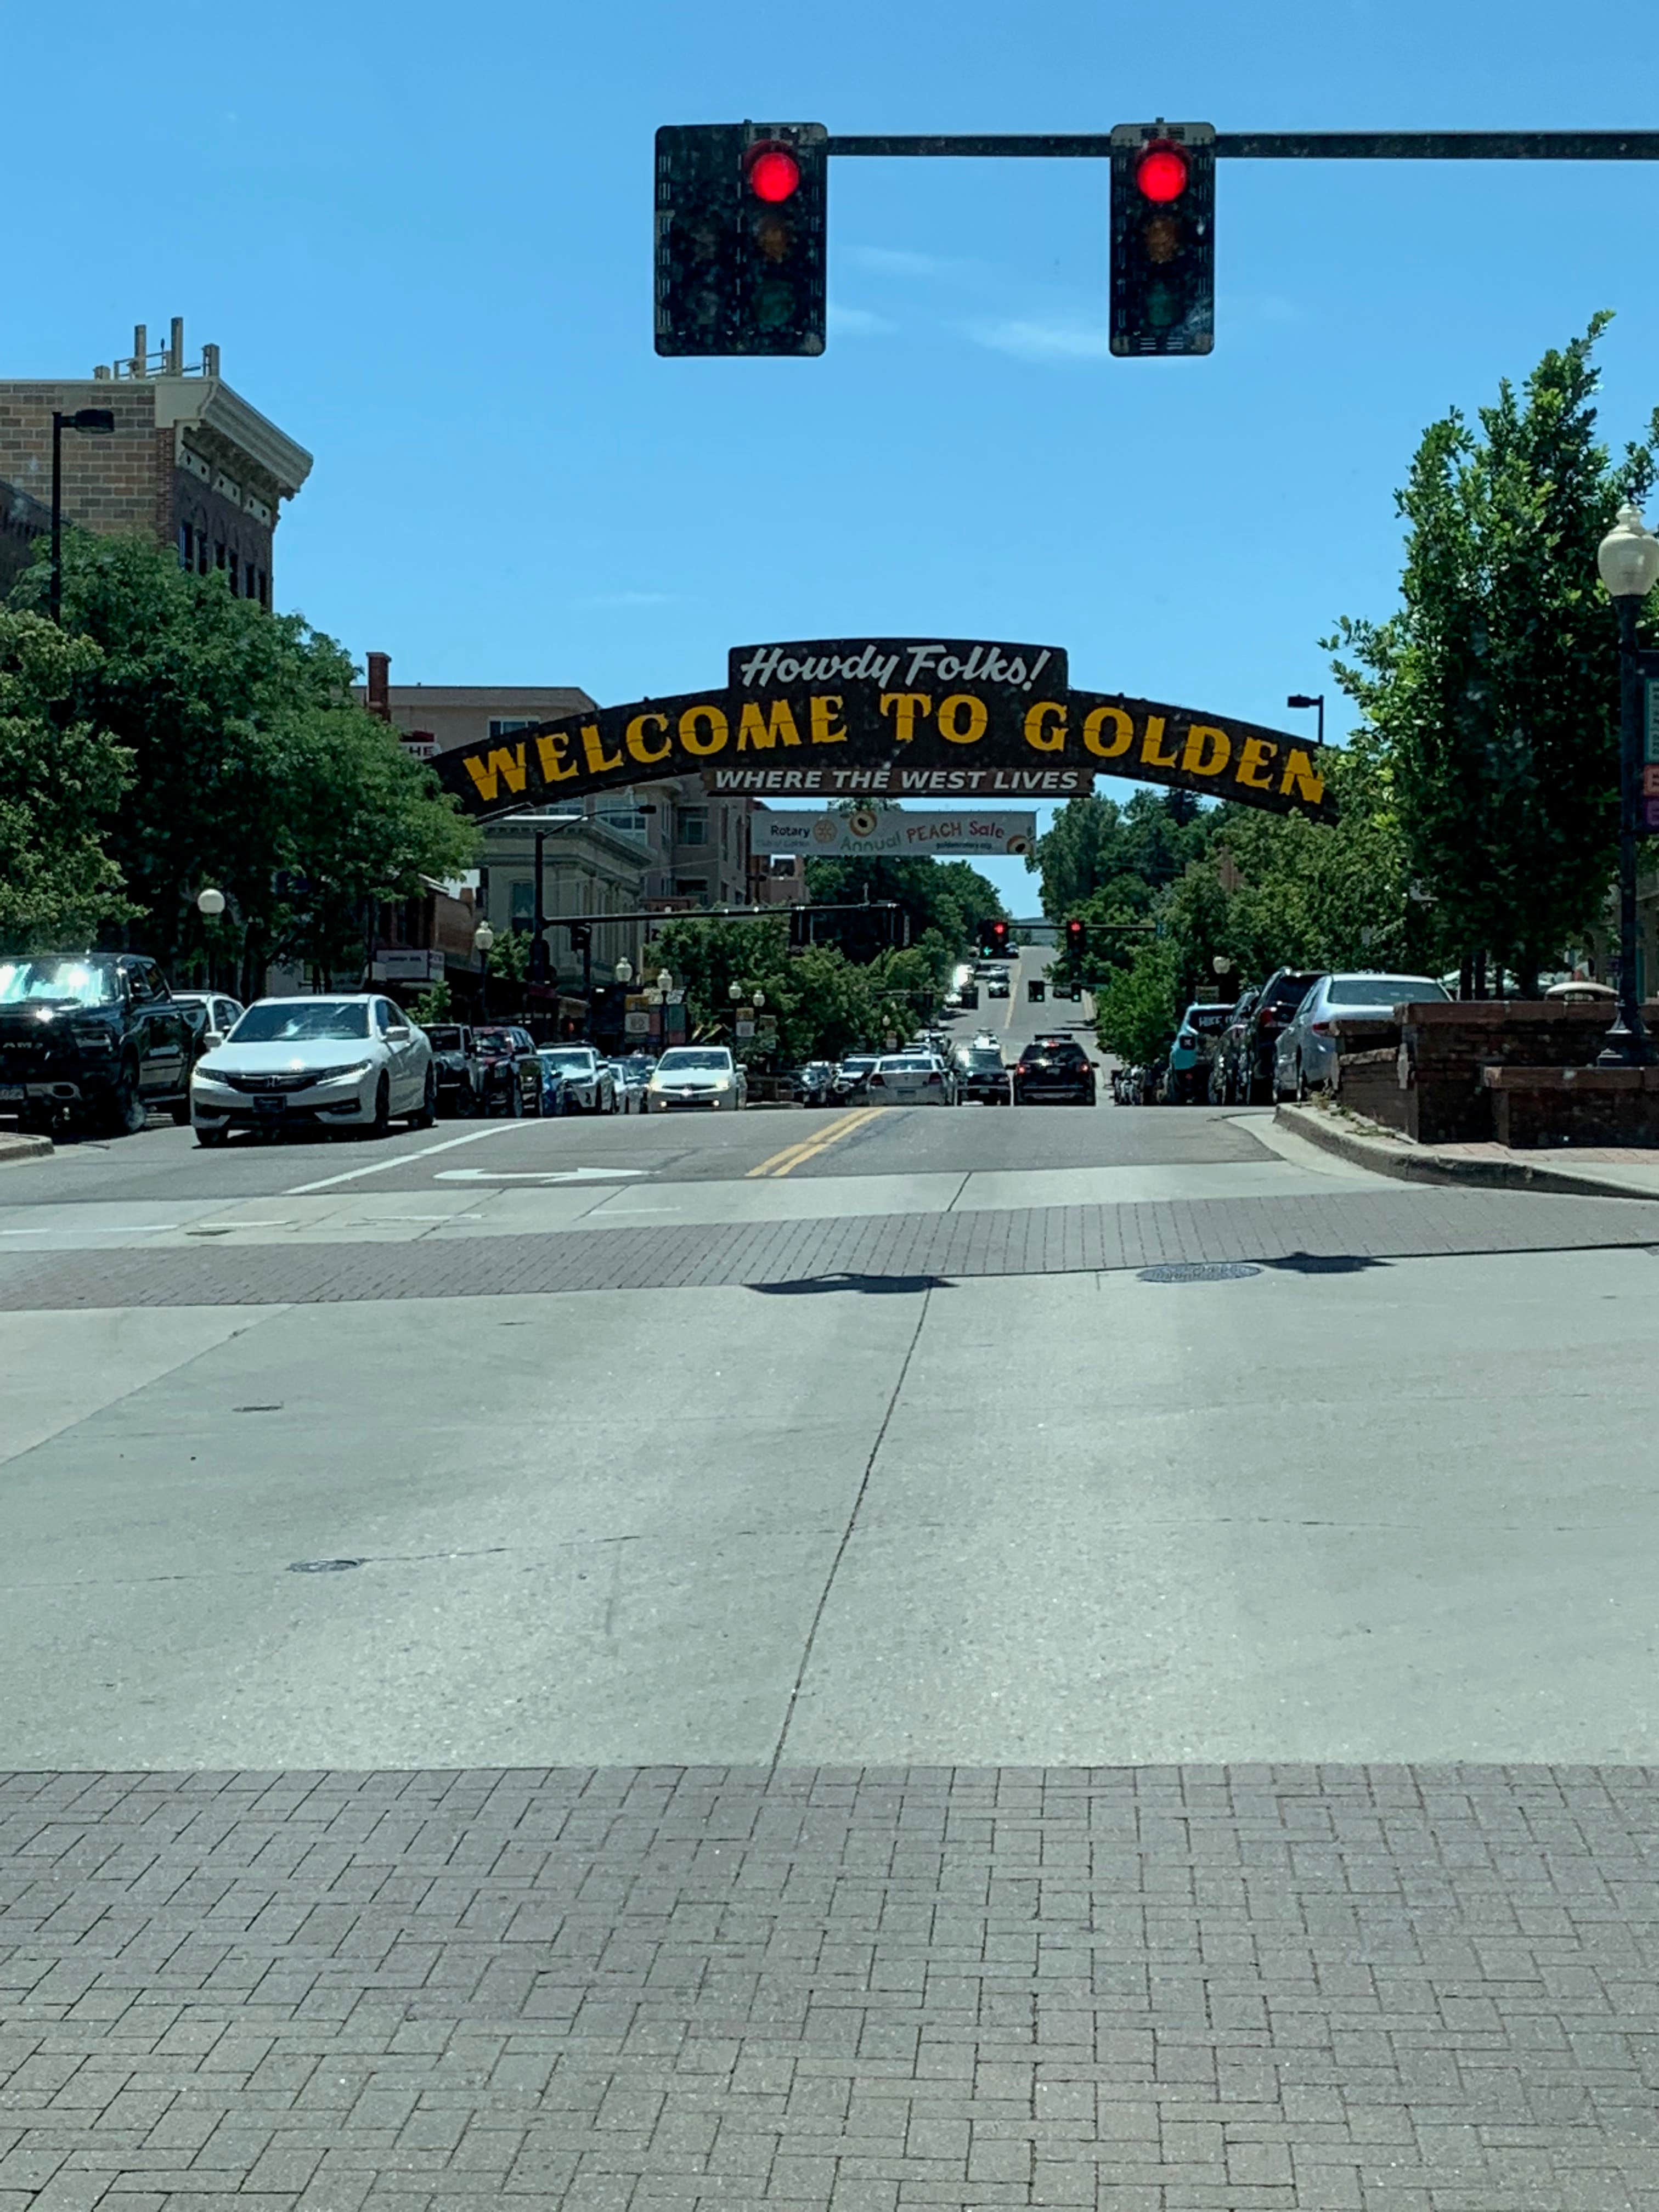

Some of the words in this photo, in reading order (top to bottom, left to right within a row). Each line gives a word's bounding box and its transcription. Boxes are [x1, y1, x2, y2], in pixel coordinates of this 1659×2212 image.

[741, 644, 900, 688] Howdy
[905, 644, 1051, 690] Folks!
[464, 695, 847, 800] WELCOME
[880, 693, 988, 743] TO
[1024, 702, 1325, 804] GOLDEN
[716, 771, 822, 788] WHERE
[833, 771, 890, 788] THE
[902, 771, 986, 788] WEST
[994, 771, 1078, 789] LIVES
[771, 825, 810, 838] Rotary
[840, 831, 901, 851] Annual
[907, 822, 962, 843] PEACH
[969, 820, 1005, 838] Sale
